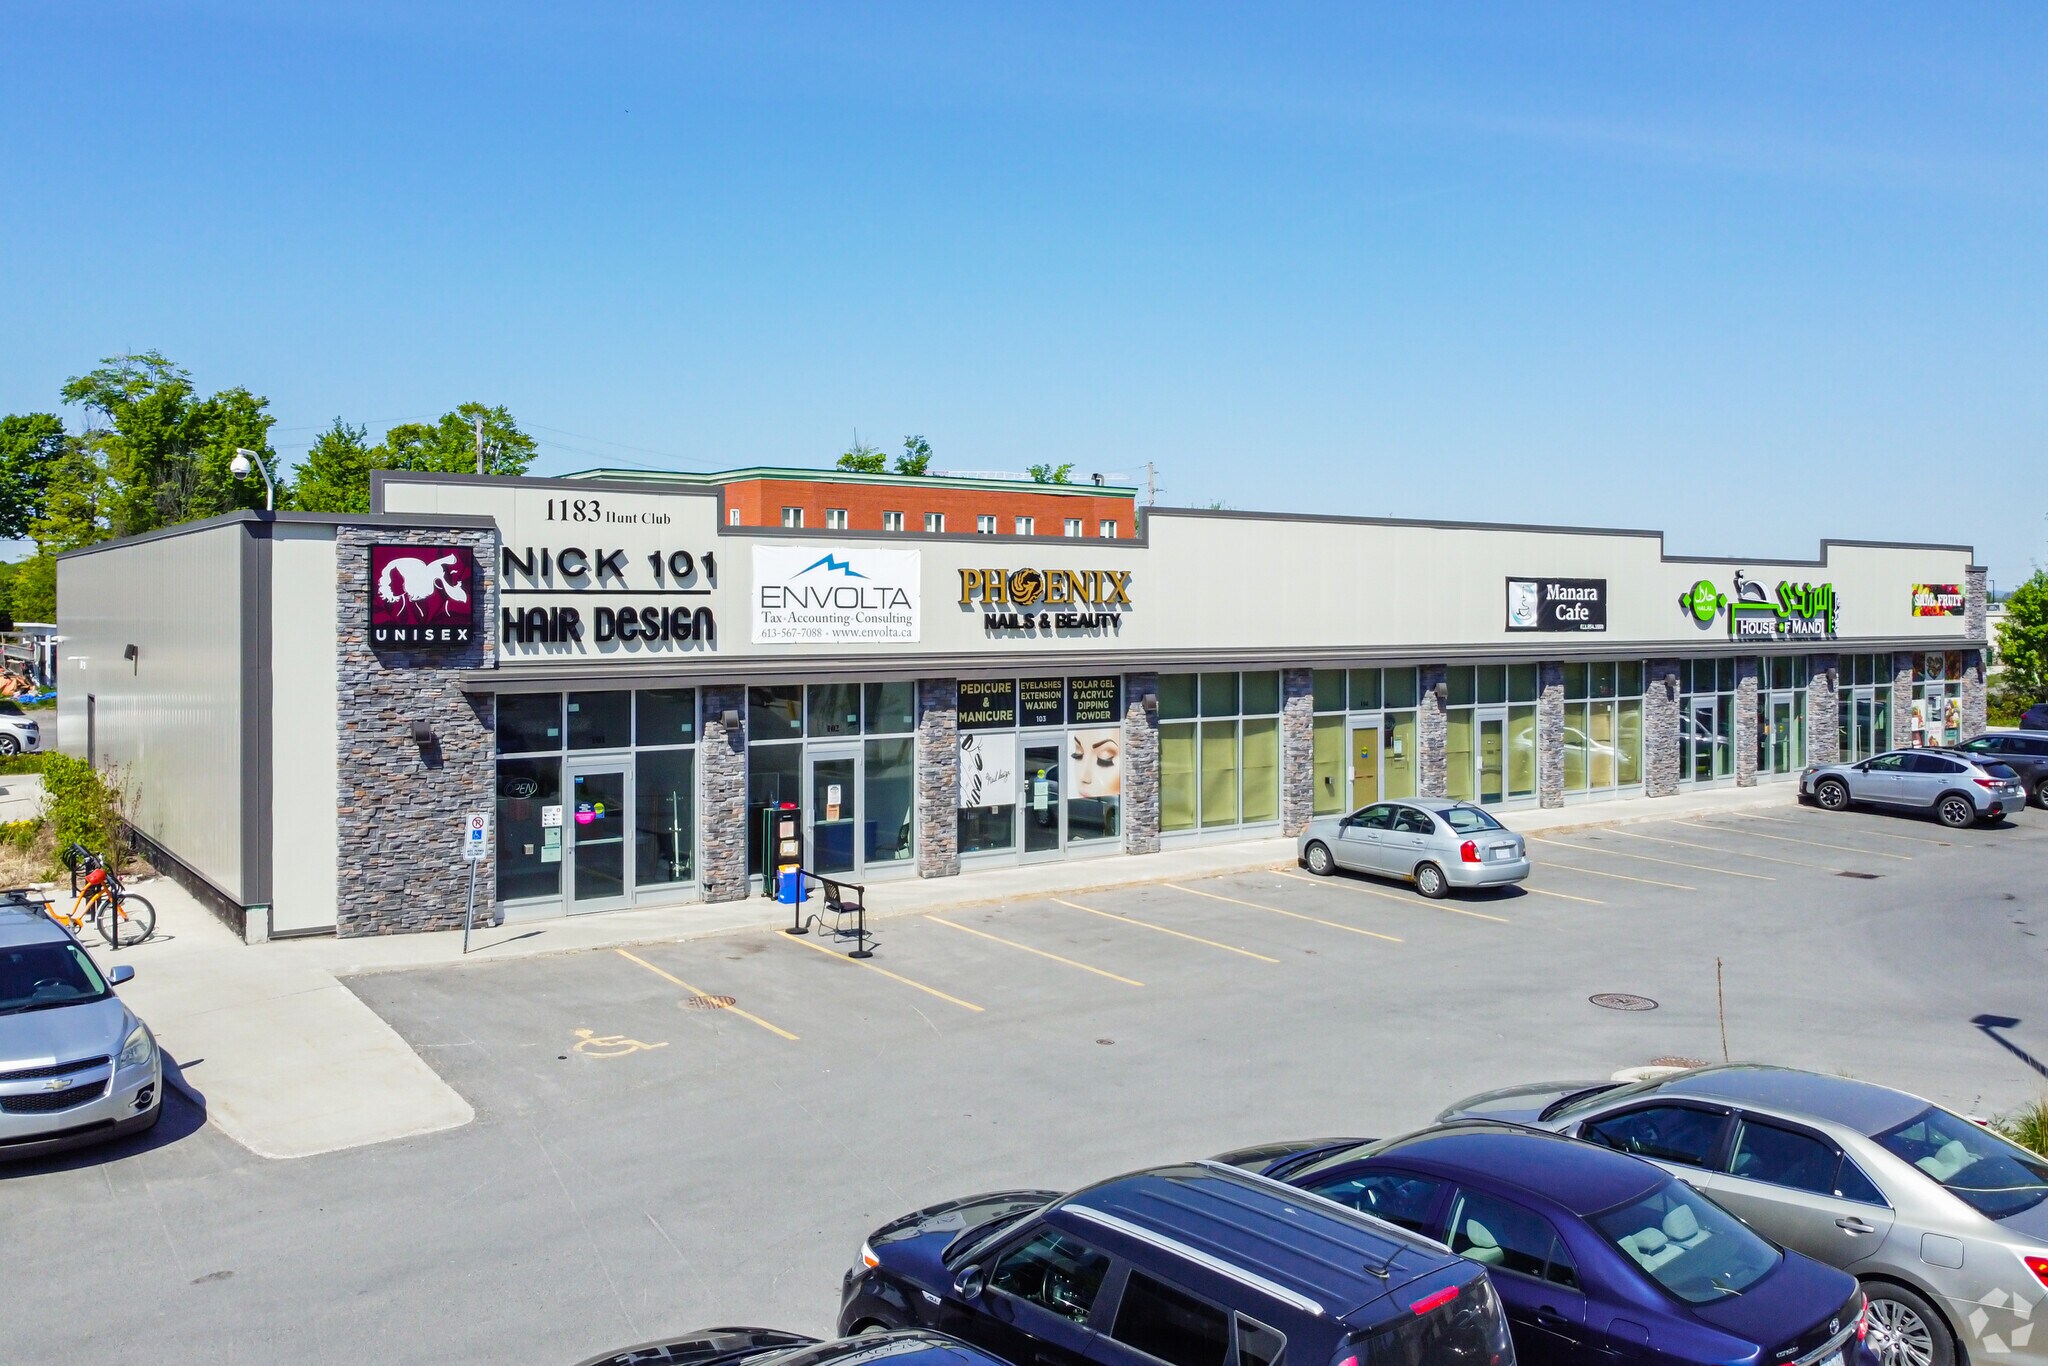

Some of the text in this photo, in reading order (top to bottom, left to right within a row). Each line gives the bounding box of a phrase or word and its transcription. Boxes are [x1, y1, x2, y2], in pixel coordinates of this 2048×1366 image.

[545, 498, 671, 525] 1183 Hunt Club
[502, 547, 714, 578] NICK 101
[761, 586, 912, 609] ENVOLTA
[1546, 584, 1597, 601] Manara
[1695, 585, 1715, 604] حلال
[1937, 594, 1962, 607] FRUIT
[1555, 602, 1589, 620] Cafe
[502, 606, 582, 643] HAIR
[761, 611, 913, 627] Tax Accounting Consulting
[984, 613, 1121, 630] NAILS & BEAUTY
[761, 626, 912, 639] 613-567-7088 www.envolta.ca
[1739, 619, 1775, 634] HOUSE
[375, 629, 468, 641] UNISEX
[960, 682, 1012, 695] PEDICURE
[1020, 680, 1062, 690] EYELASHES
[1072, 679, 1115, 689] SOLAR GEL
[1021, 691, 1062, 700] EXTENSION
[1073, 690, 1114, 700] & ACRYLIC
[982, 697, 990, 708] &
[1025, 700, 1058, 710] WAXING
[1078, 701, 1109, 710] DIPPING
[959, 710, 1013, 723] MANICURE
[1036, 715, 1047, 723] 103
[1076, 711, 1111, 721] POWDER
